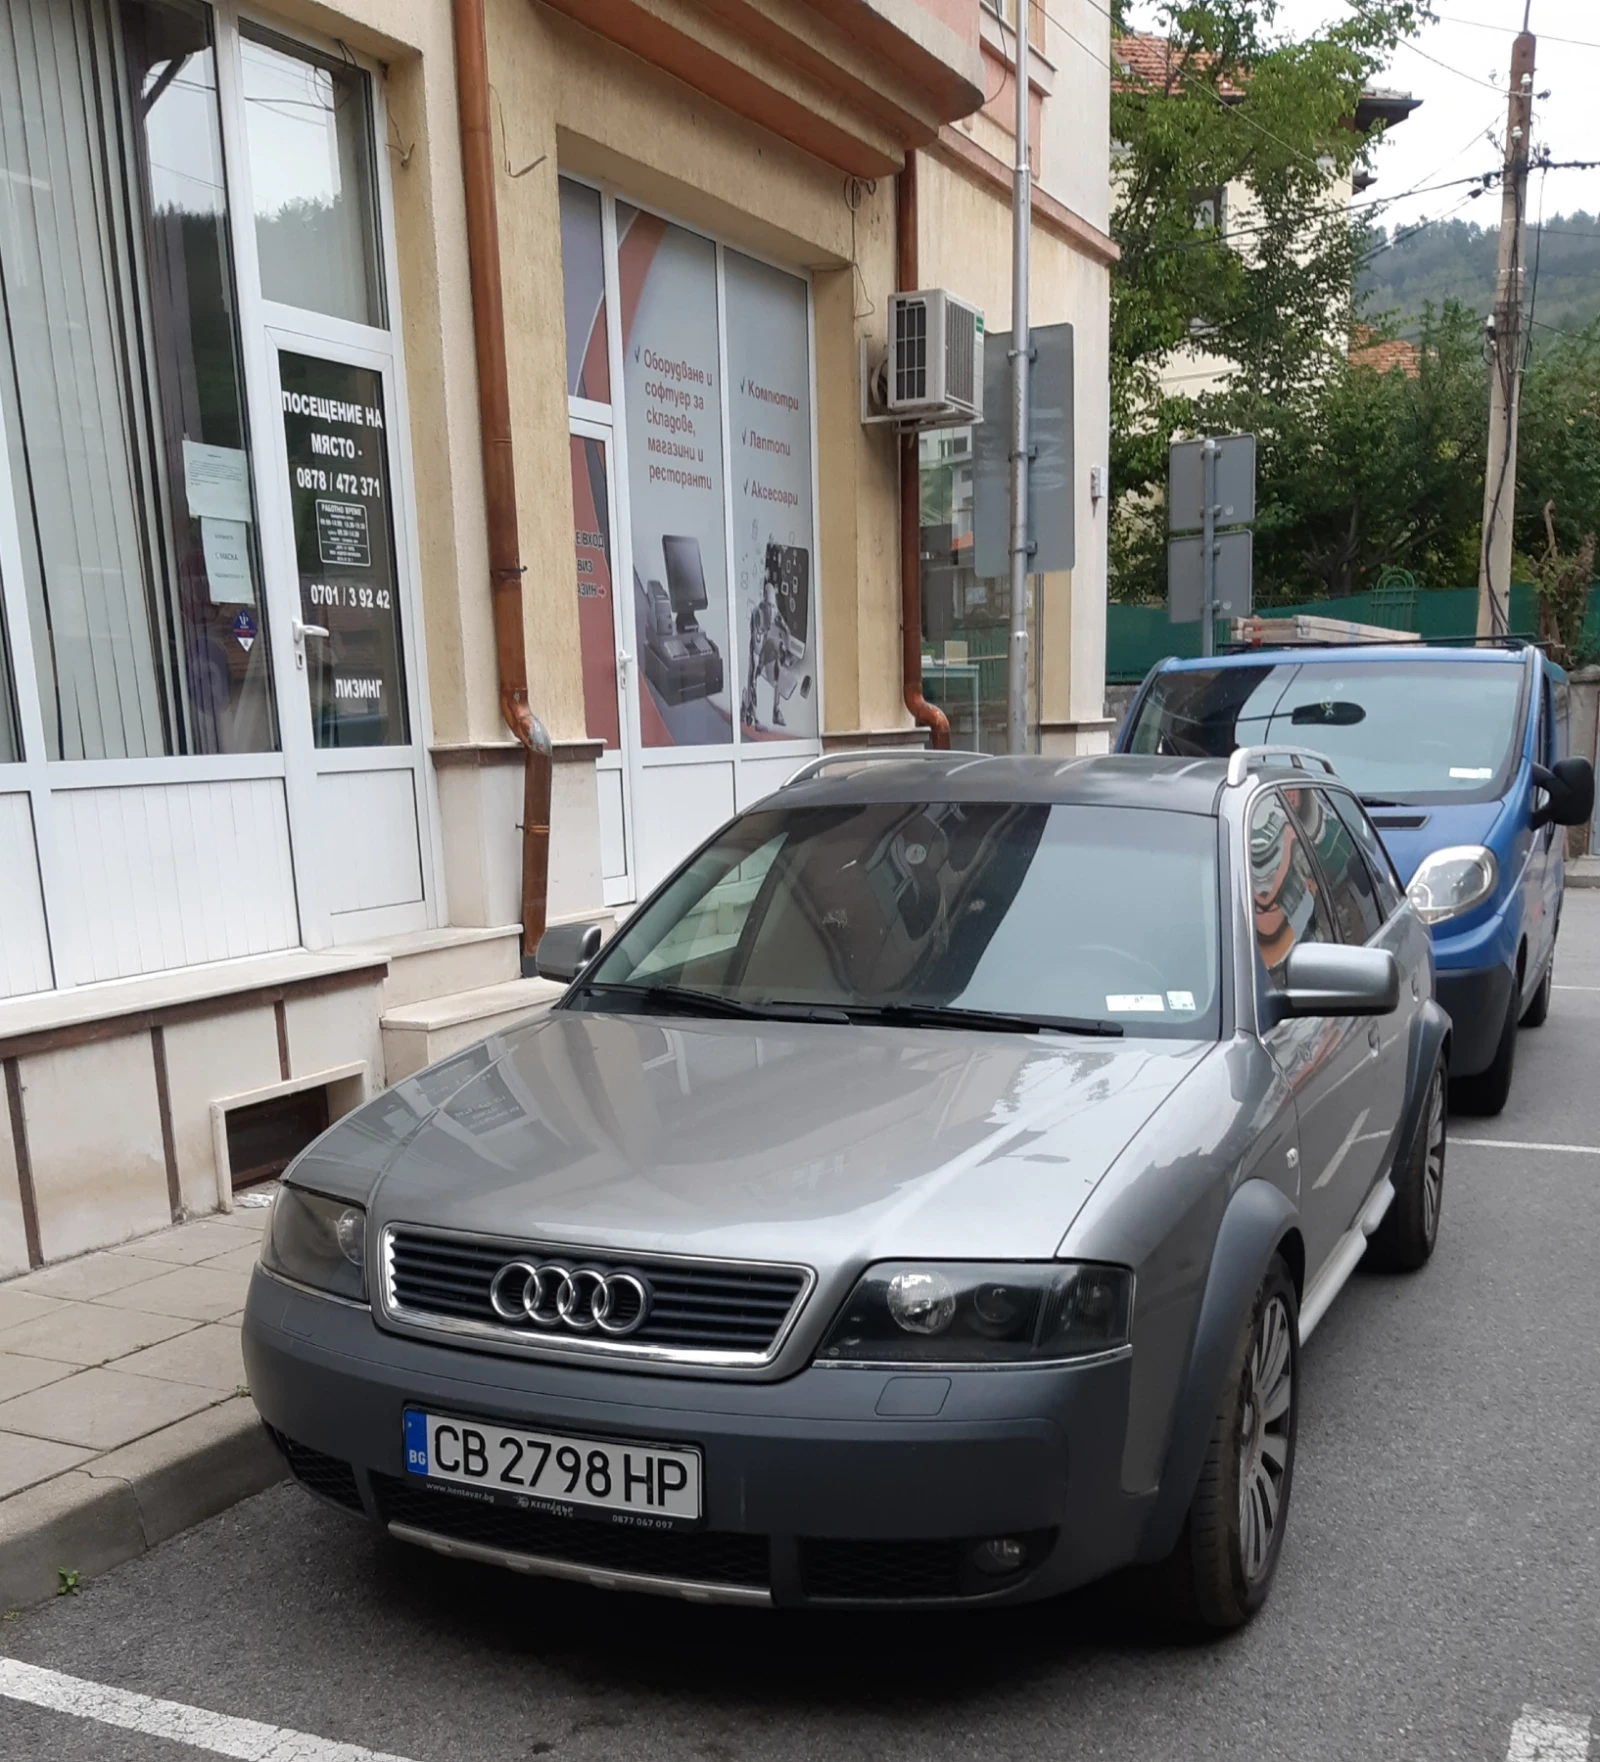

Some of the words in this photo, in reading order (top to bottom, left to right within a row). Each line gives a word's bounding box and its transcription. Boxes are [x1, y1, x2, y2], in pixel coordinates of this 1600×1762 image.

[644, 349, 704, 384] Оборудване
[706, 373, 713, 386] и
[645, 382, 690, 410] софтуер
[694, 395, 704, 410] за
[748, 379, 799, 412] Компютри
[282, 391, 363, 424] ПОСЕЩЕНИЕ
[366, 407, 383, 429] НА
[646, 405, 696, 437] складове,
[311, 433, 355, 459] МЯСТО
[648, 437, 695, 461] магазини
[698, 448, 704, 462] и
[750, 430, 791, 457] Лаптопи
[297, 467, 327, 491] 0878
[336, 473, 358, 495] 472
[360, 476, 380, 498] 371
[649, 464, 712, 490] ресторанти
[751, 480, 798, 508] Аксесоари
[583, 533, 604, 548] ВХОД
[311, 584, 339, 606] 0701
[349, 587, 357, 607] 3
[359, 588, 374, 608] 92
[376, 589, 391, 609] 42
[335, 679, 383, 699] ЛИЗИНГ
[409, 1450, 427, 1466] BG
[434, 1424, 489, 1478] CB
[499, 1436, 612, 1498] 2798
[623, 1453, 688, 1507] HP
[426, 1482, 495, 1504] www.kentavar.bg
[612, 1515, 635, 1525] 0877
